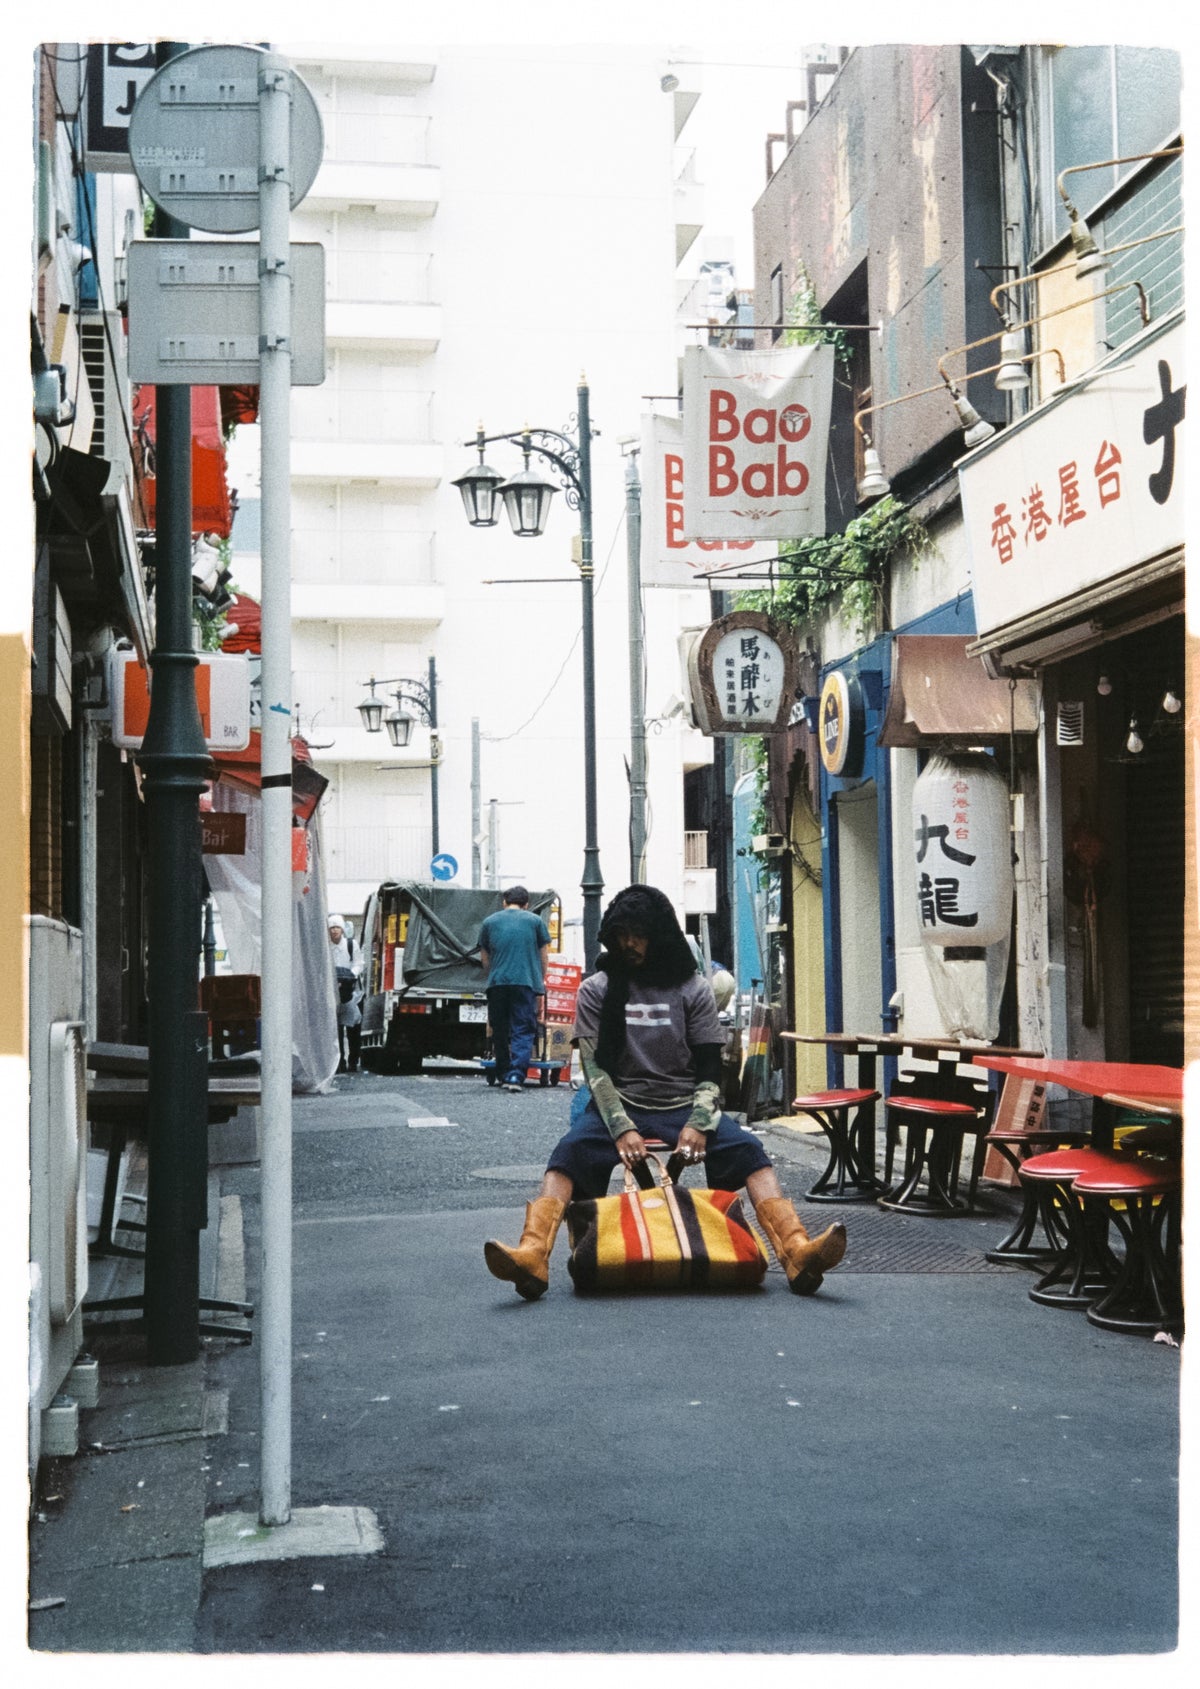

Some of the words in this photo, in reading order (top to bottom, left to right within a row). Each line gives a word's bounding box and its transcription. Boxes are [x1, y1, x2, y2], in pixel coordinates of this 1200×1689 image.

[708, 389, 812, 444] Bao
[708, 444, 810, 498] Bab
[991, 440, 1121, 564] 香港屋台
[763, 651, 773, 709] あしび
[223, 725, 239, 737] BAR
[202, 828, 229, 846] Bar
[952, 780, 971, 841] 香港屋台
[915, 814, 978, 928] 九龍
